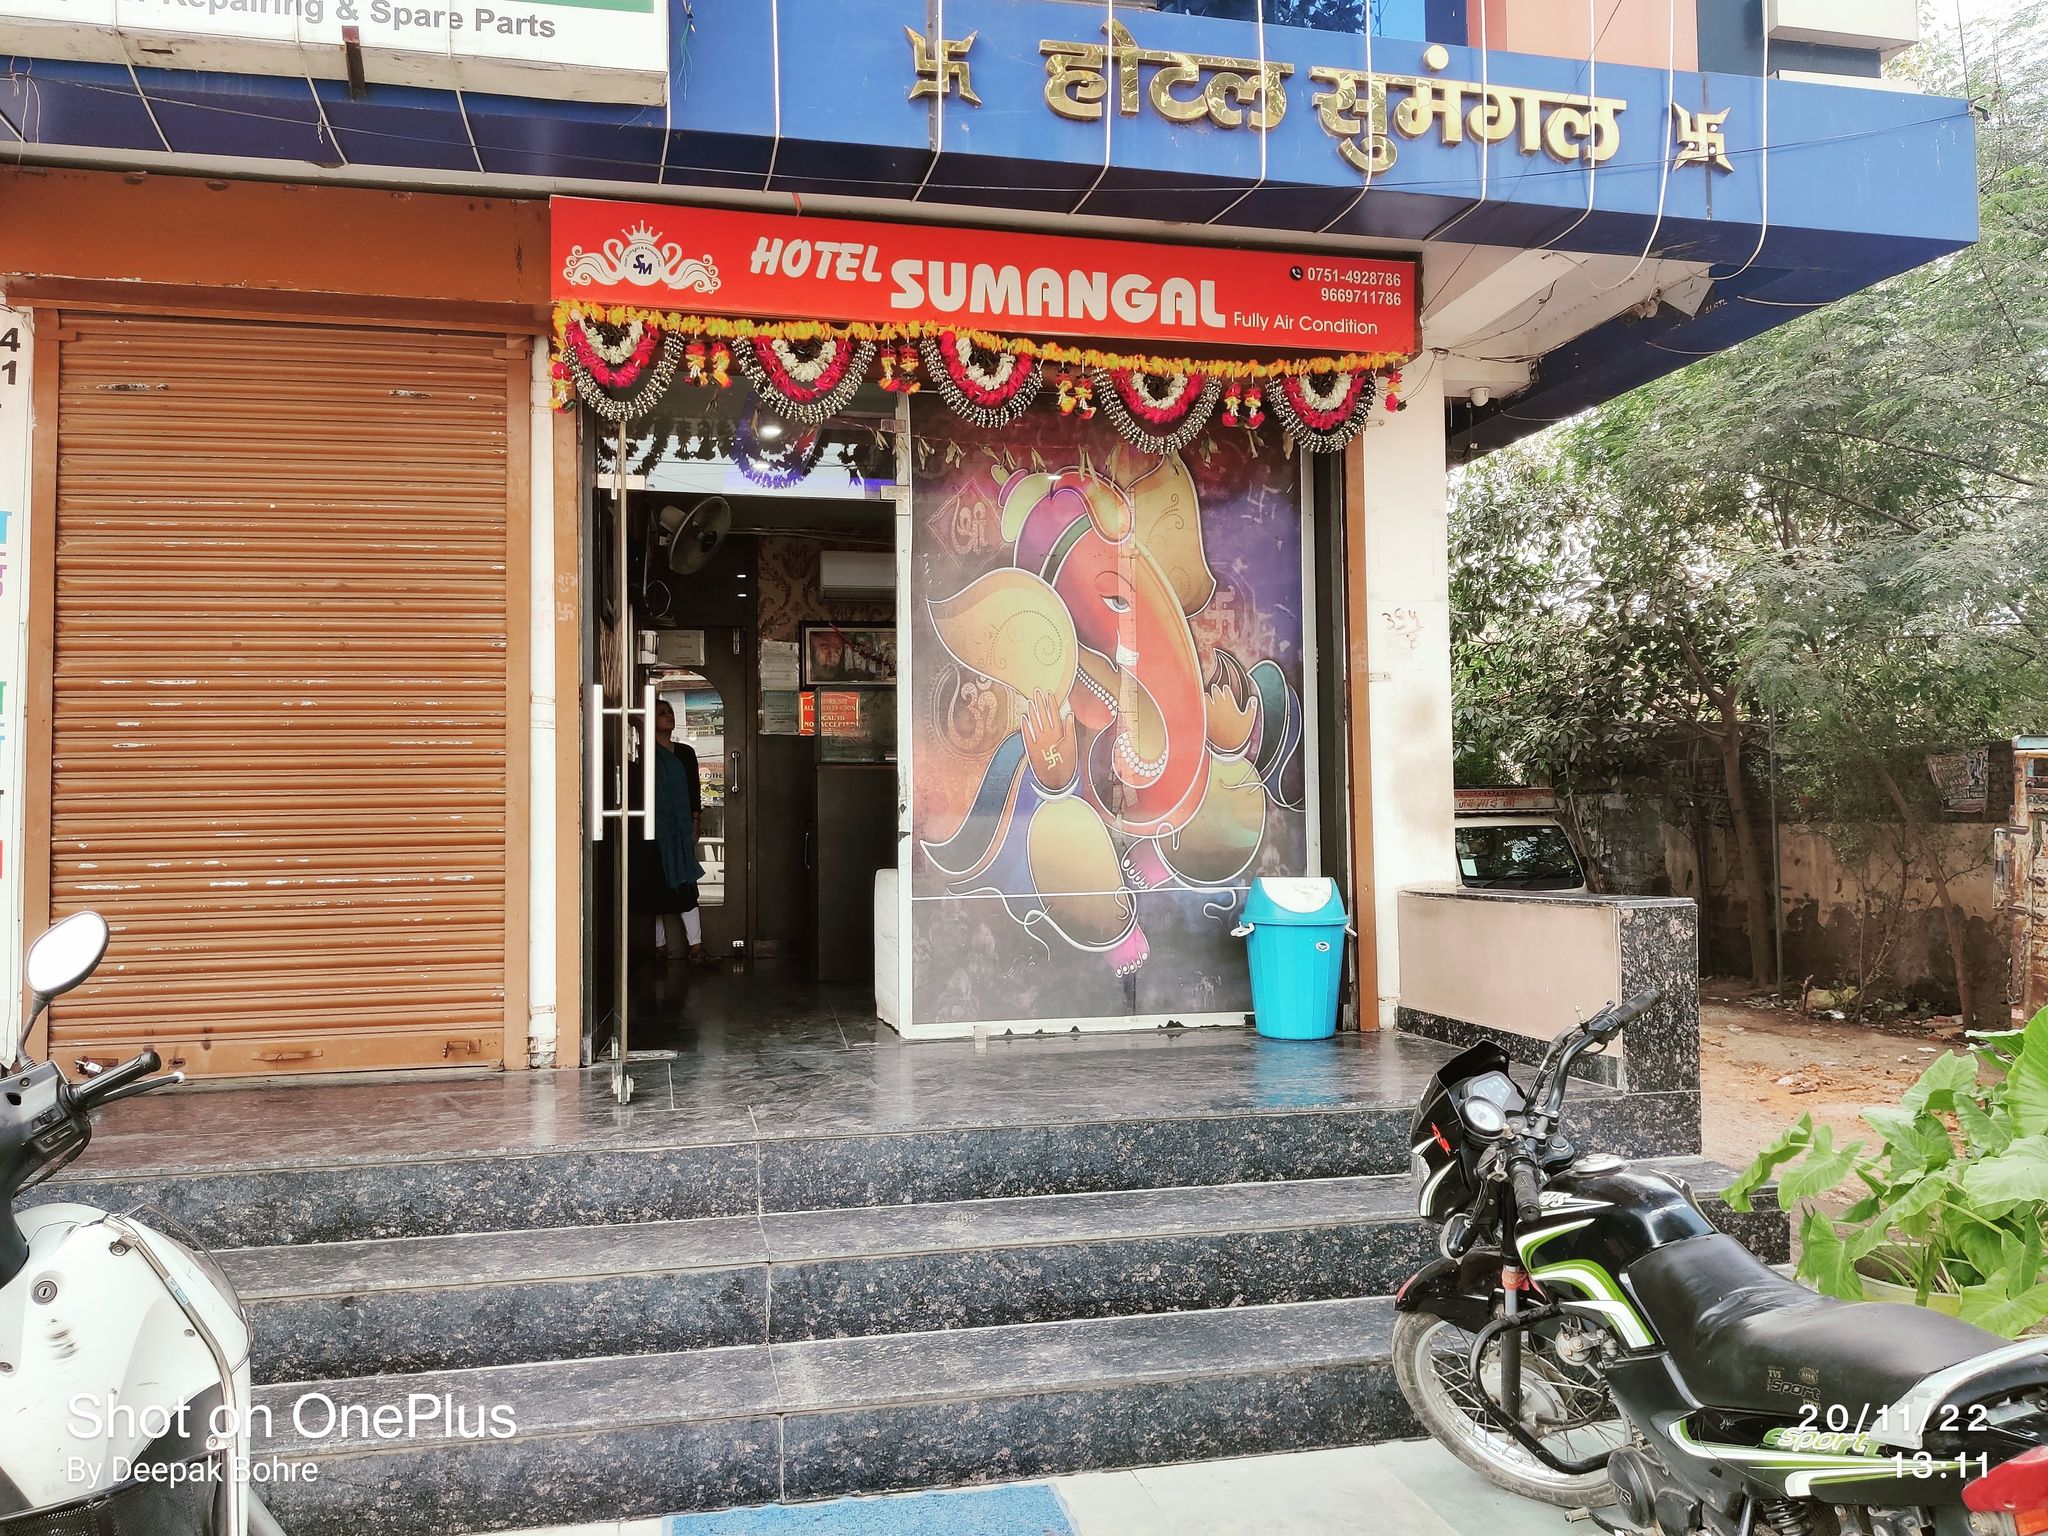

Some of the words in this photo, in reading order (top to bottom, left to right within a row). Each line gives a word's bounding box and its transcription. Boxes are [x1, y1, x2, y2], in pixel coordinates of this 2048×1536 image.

[163, 0, 324, 24] pairing
[336, 0, 359, 21] &
[370, 0, 463, 31] Spare
[475, 8, 556, 38] Parts
[1039, 18, 1294, 131] होटल
[1309, 44, 1627, 174] सुमंगल
[750, 236, 882, 283] HOTEL
[890, 259, 1226, 328] SUMANGAL
[1307, 266, 1401, 287] 0751-4928786
[1321, 287, 1401, 306] 9669711786
[1233, 311, 1269, 331] Fully
[1274, 315, 1294, 330] Air
[1299, 315, 1378, 335] Condition
